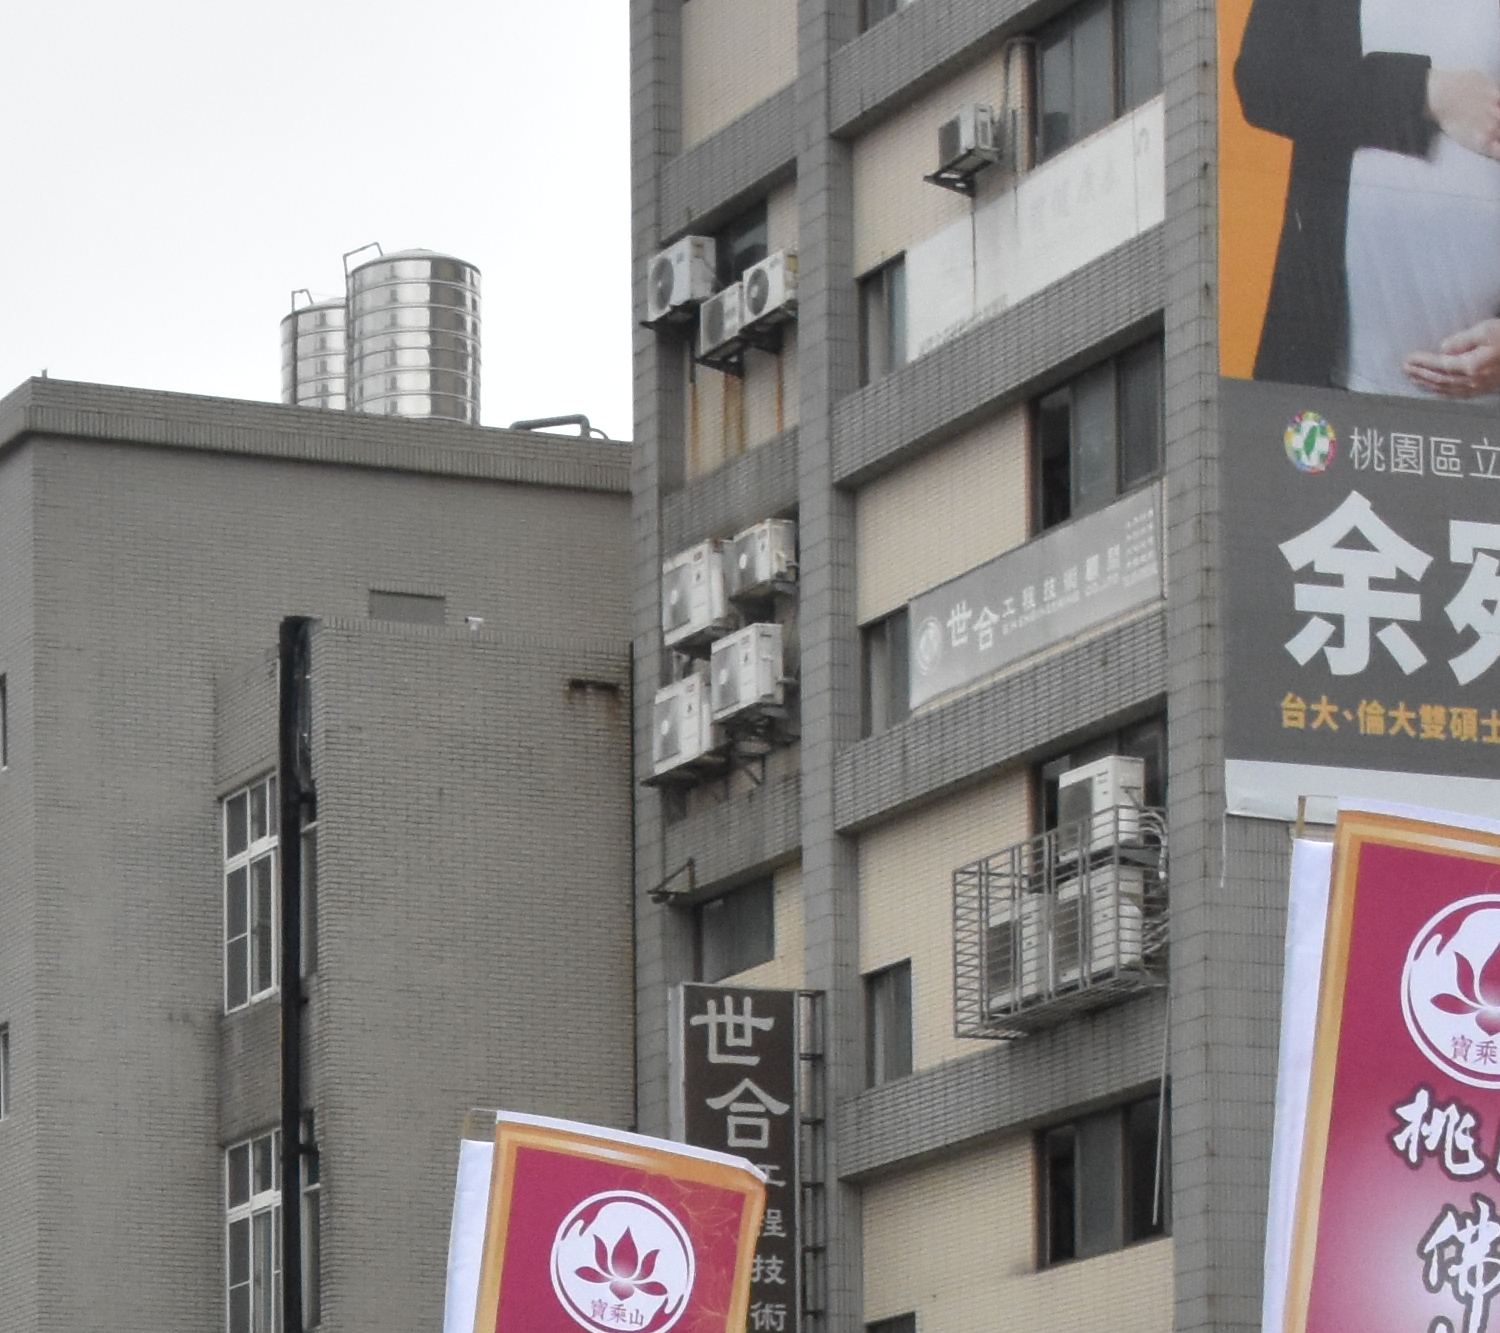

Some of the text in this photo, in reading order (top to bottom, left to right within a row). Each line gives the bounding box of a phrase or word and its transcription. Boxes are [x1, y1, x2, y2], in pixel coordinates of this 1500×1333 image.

[690, 995, 790, 1149] 世合
[589, 1297, 646, 1329] 寶乘山
